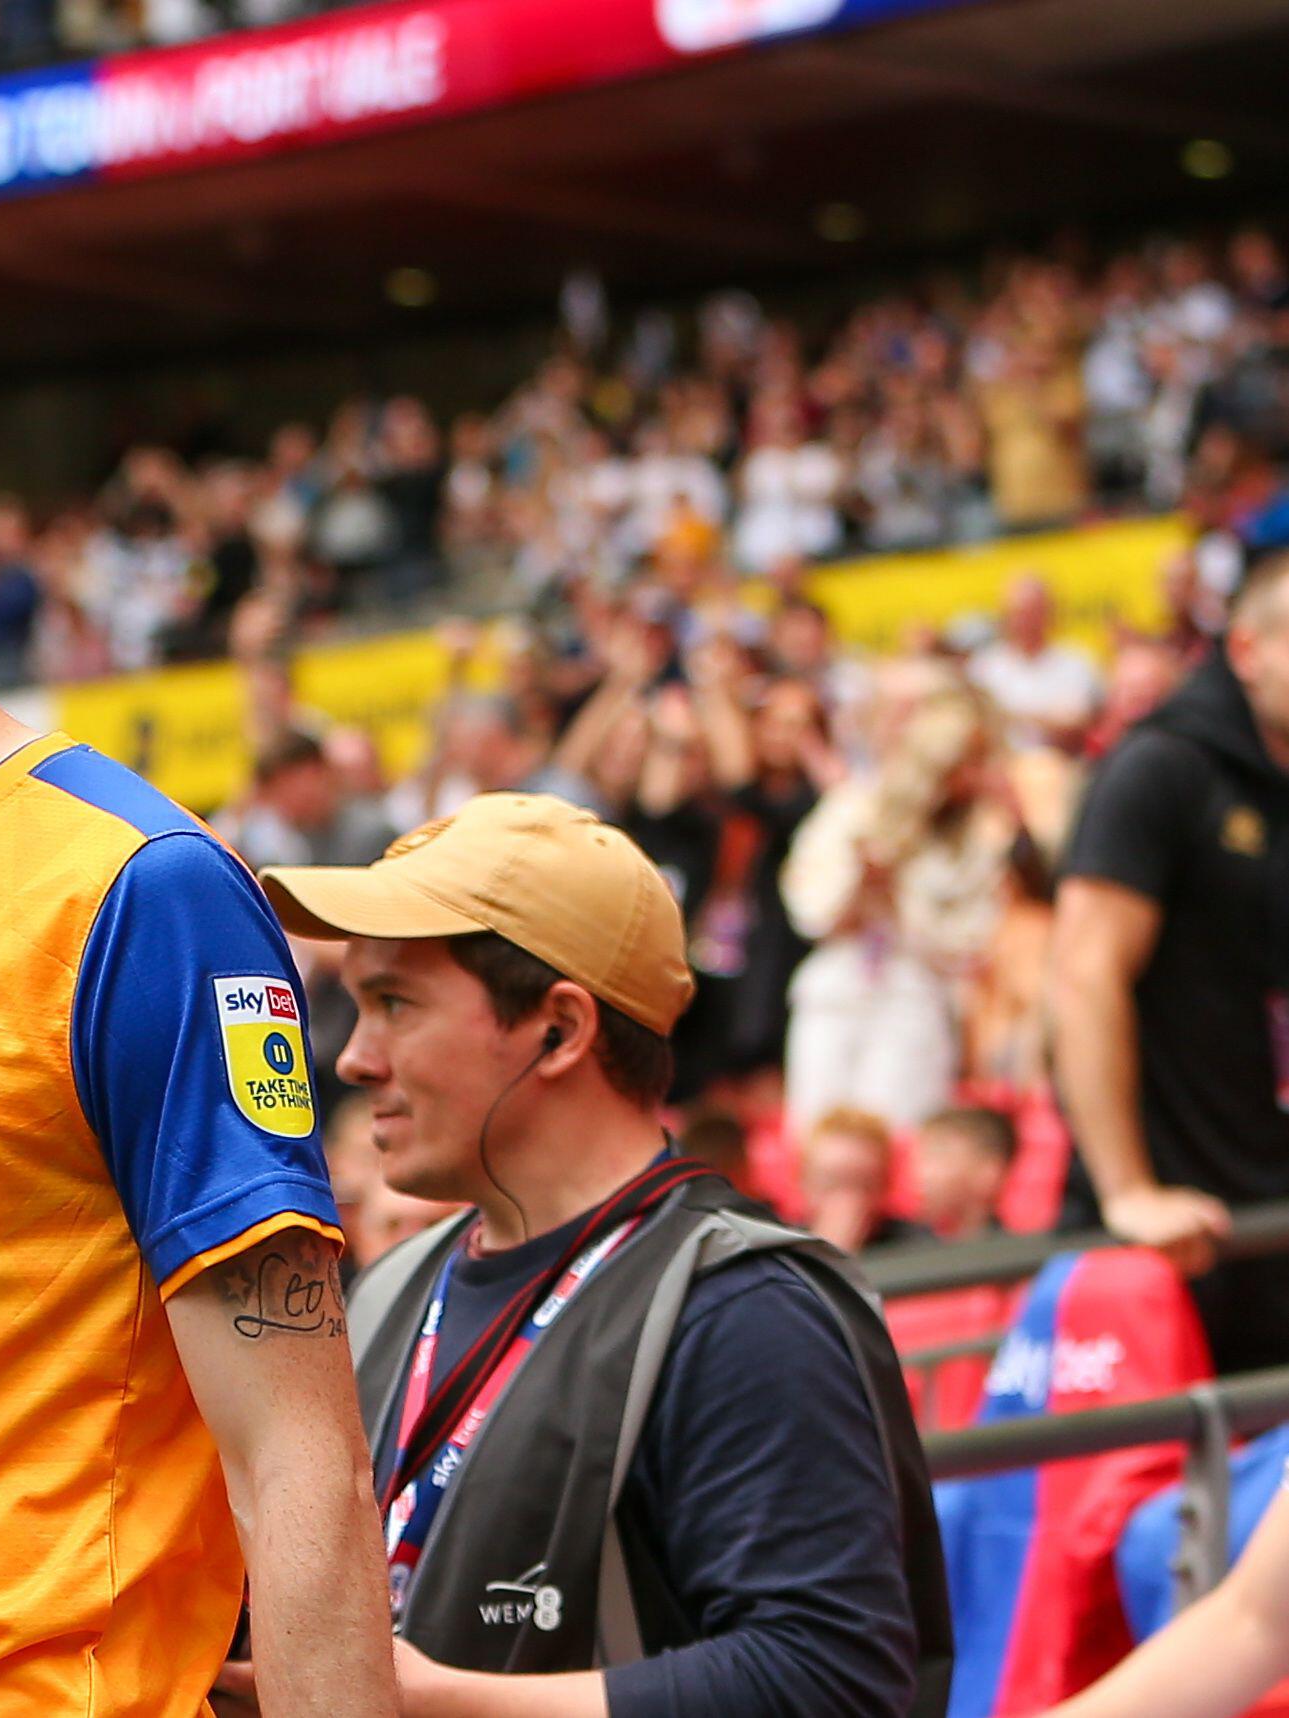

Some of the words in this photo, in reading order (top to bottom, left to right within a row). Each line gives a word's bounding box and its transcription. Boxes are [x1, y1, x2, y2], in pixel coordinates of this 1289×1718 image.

[225, 988, 264, 1015] sky
[268, 988, 295, 1013] bet
[246, 1079, 285, 1096] TAKE
[253, 1095, 277, 1111] TO
[234, 1251, 326, 1338] Leo
[431, 1447, 462, 1489] sky
